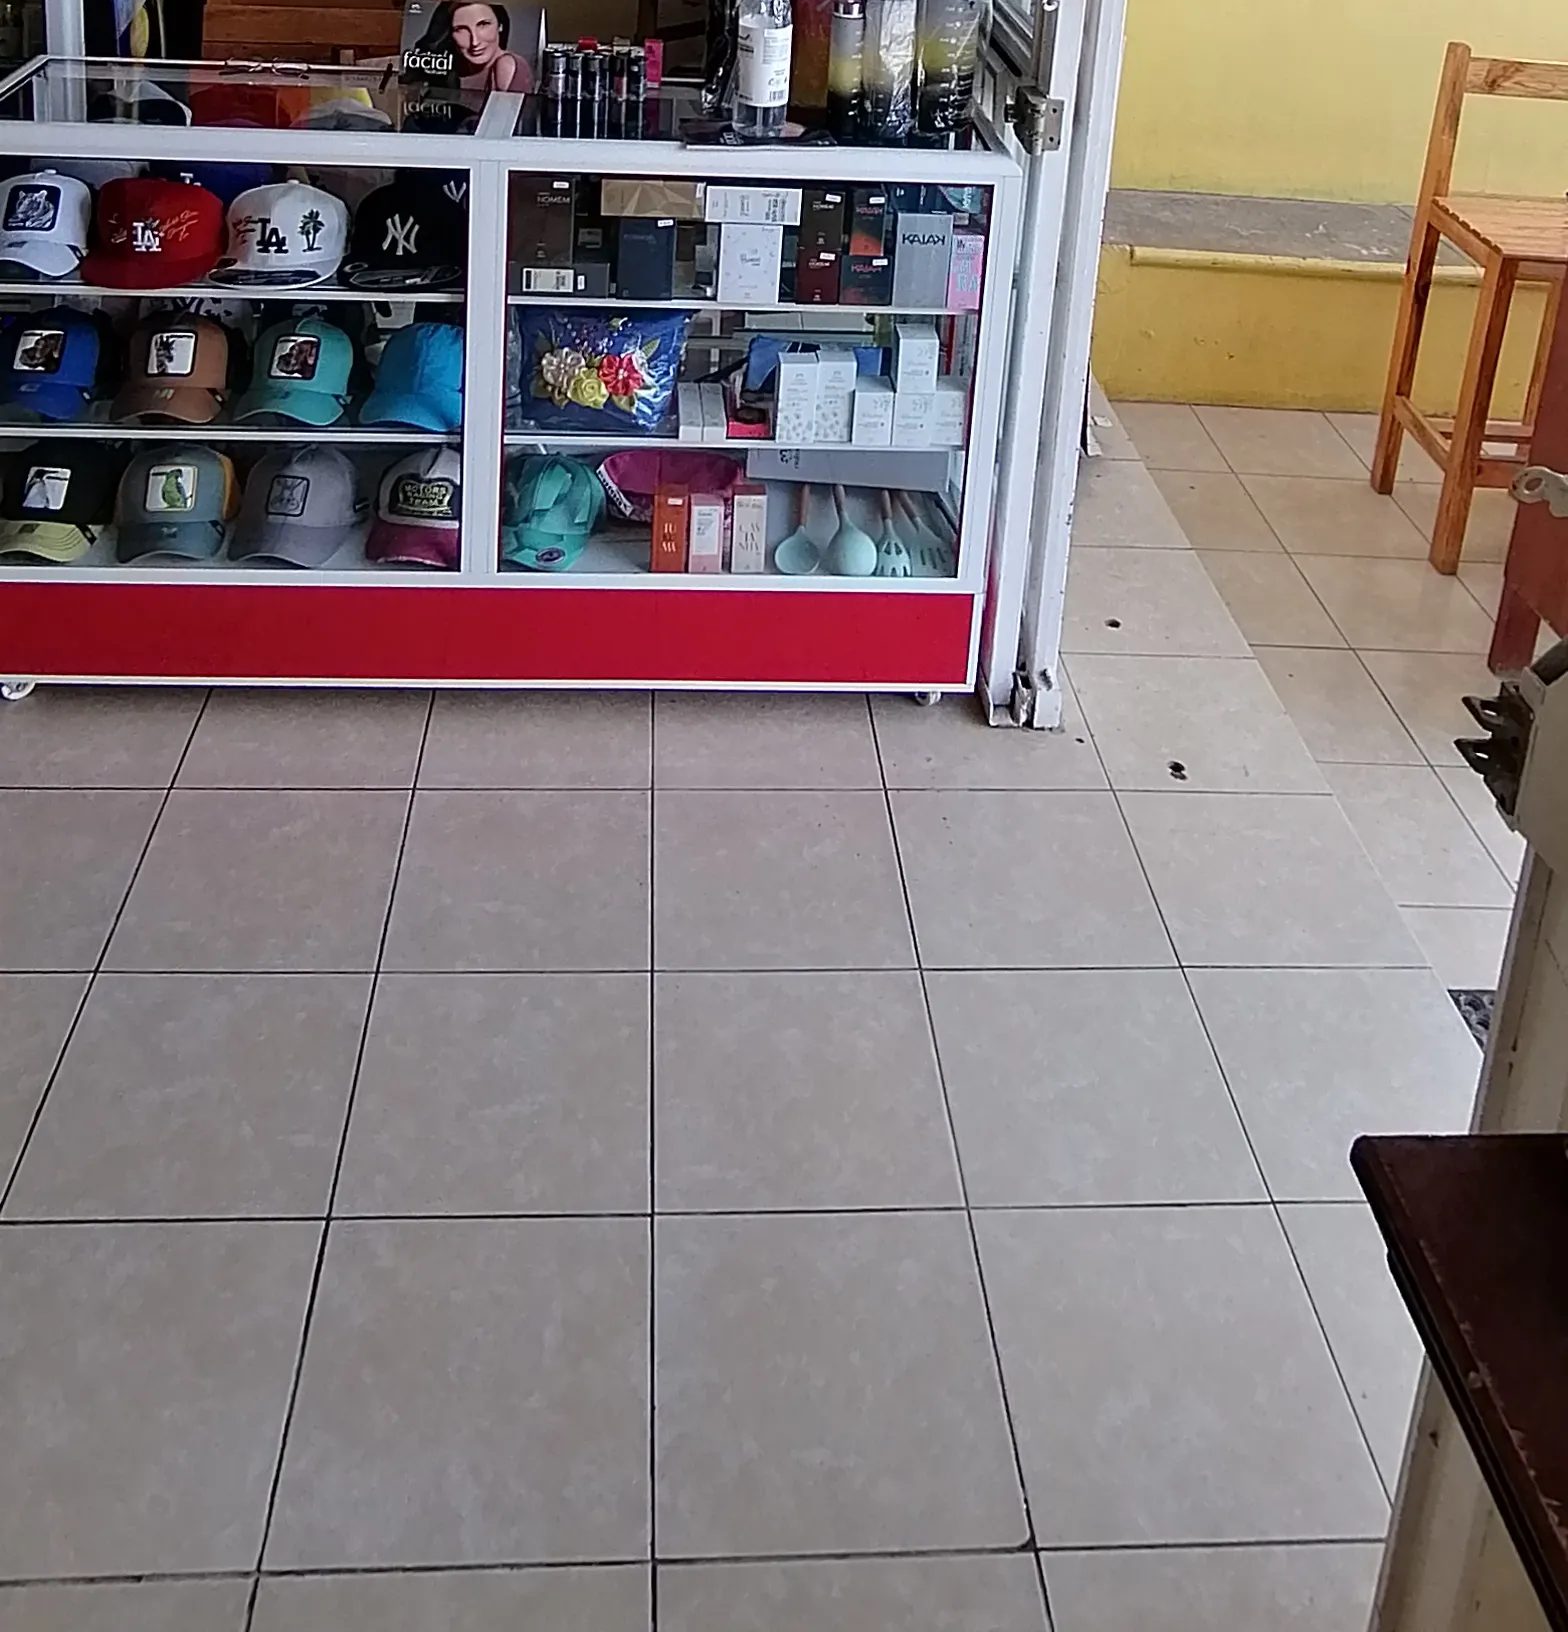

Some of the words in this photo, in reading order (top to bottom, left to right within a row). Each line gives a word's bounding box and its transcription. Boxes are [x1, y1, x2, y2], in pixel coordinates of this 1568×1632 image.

[404, 51, 453, 71] facial
[256, 217, 289, 254] LA
[382, 213, 420, 256] NY
[902, 233, 946, 246] KAIAK
